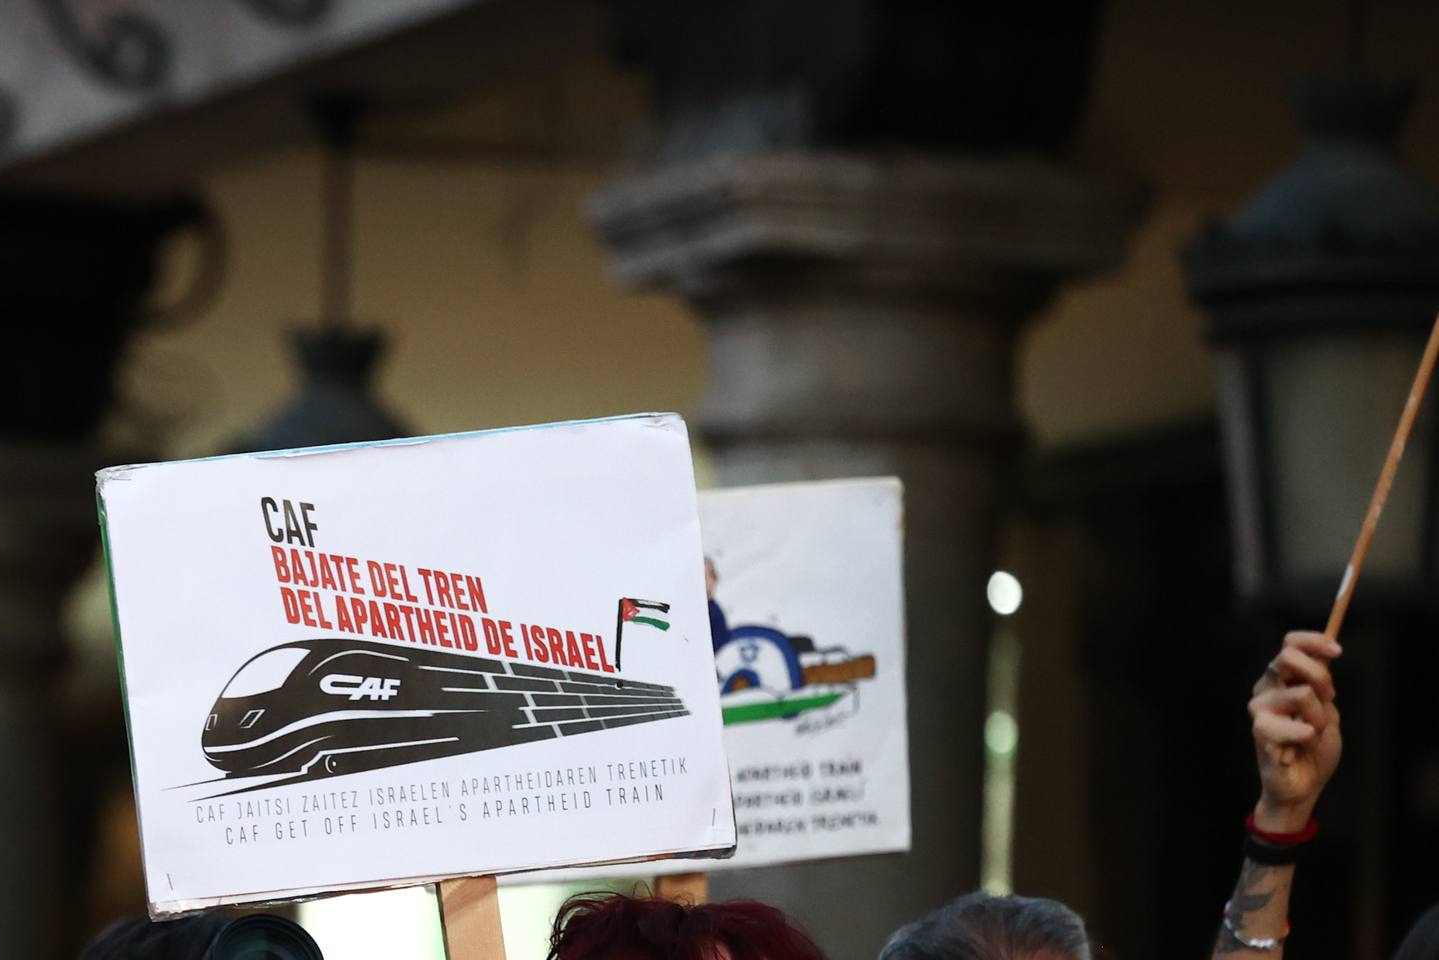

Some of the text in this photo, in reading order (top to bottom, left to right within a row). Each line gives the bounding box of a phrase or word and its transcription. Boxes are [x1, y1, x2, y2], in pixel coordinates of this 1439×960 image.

[260, 496, 318, 547] CAF
[270, 545, 488, 614] BAJATE DEL TREN
[280, 586, 615, 673] DEL APARTHEID DE ISRAEL
[319, 673, 402, 701] CAF
[196, 756, 689, 824] CAF JAITSI ZAITEZ ISRAELEN APARTHEIDAREN TRENETIK
[225, 825, 260, 846] CAF
[275, 819, 308, 840] GET
[324, 815, 358, 836] OFF
[482, 790, 593, 820] APARTHEID
[605, 783, 664, 807] TRAIN
